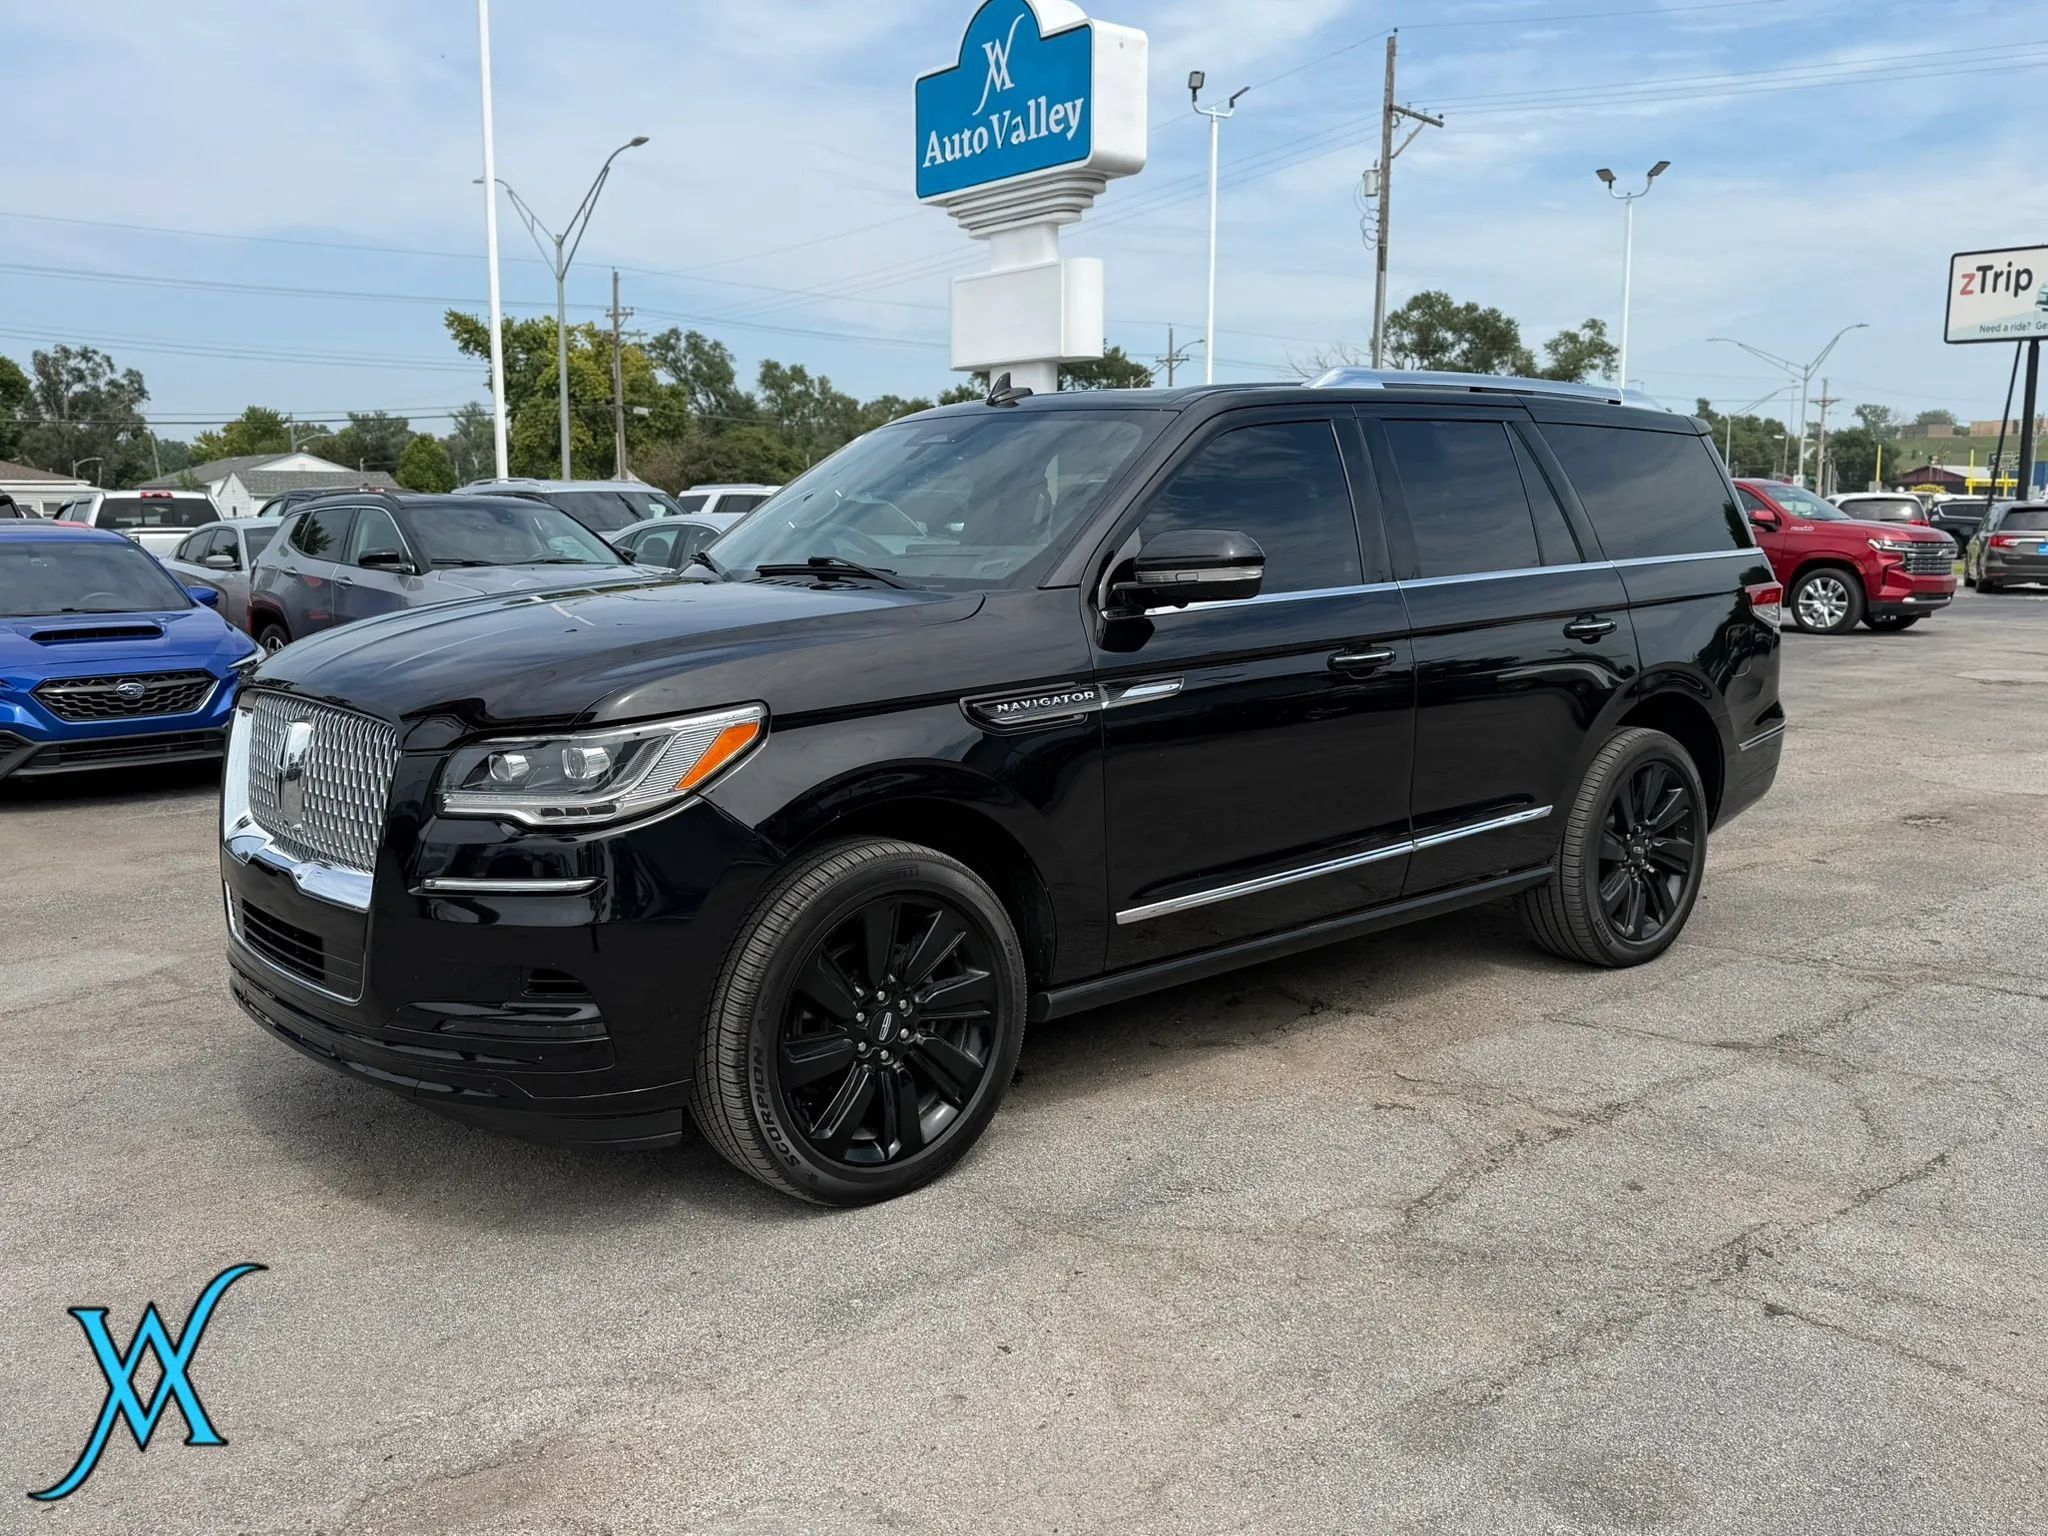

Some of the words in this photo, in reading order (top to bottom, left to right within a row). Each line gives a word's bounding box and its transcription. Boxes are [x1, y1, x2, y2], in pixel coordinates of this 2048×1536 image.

[1960, 261, 2033, 298] zTrip
[1980, 322, 2001, 333] Need
[2003, 324, 2009, 332] a
[2011, 321, 2031, 332] ride?
[997, 690, 1095, 713] NAVIGATOR
[752, 1046, 800, 1167] SCORPION
